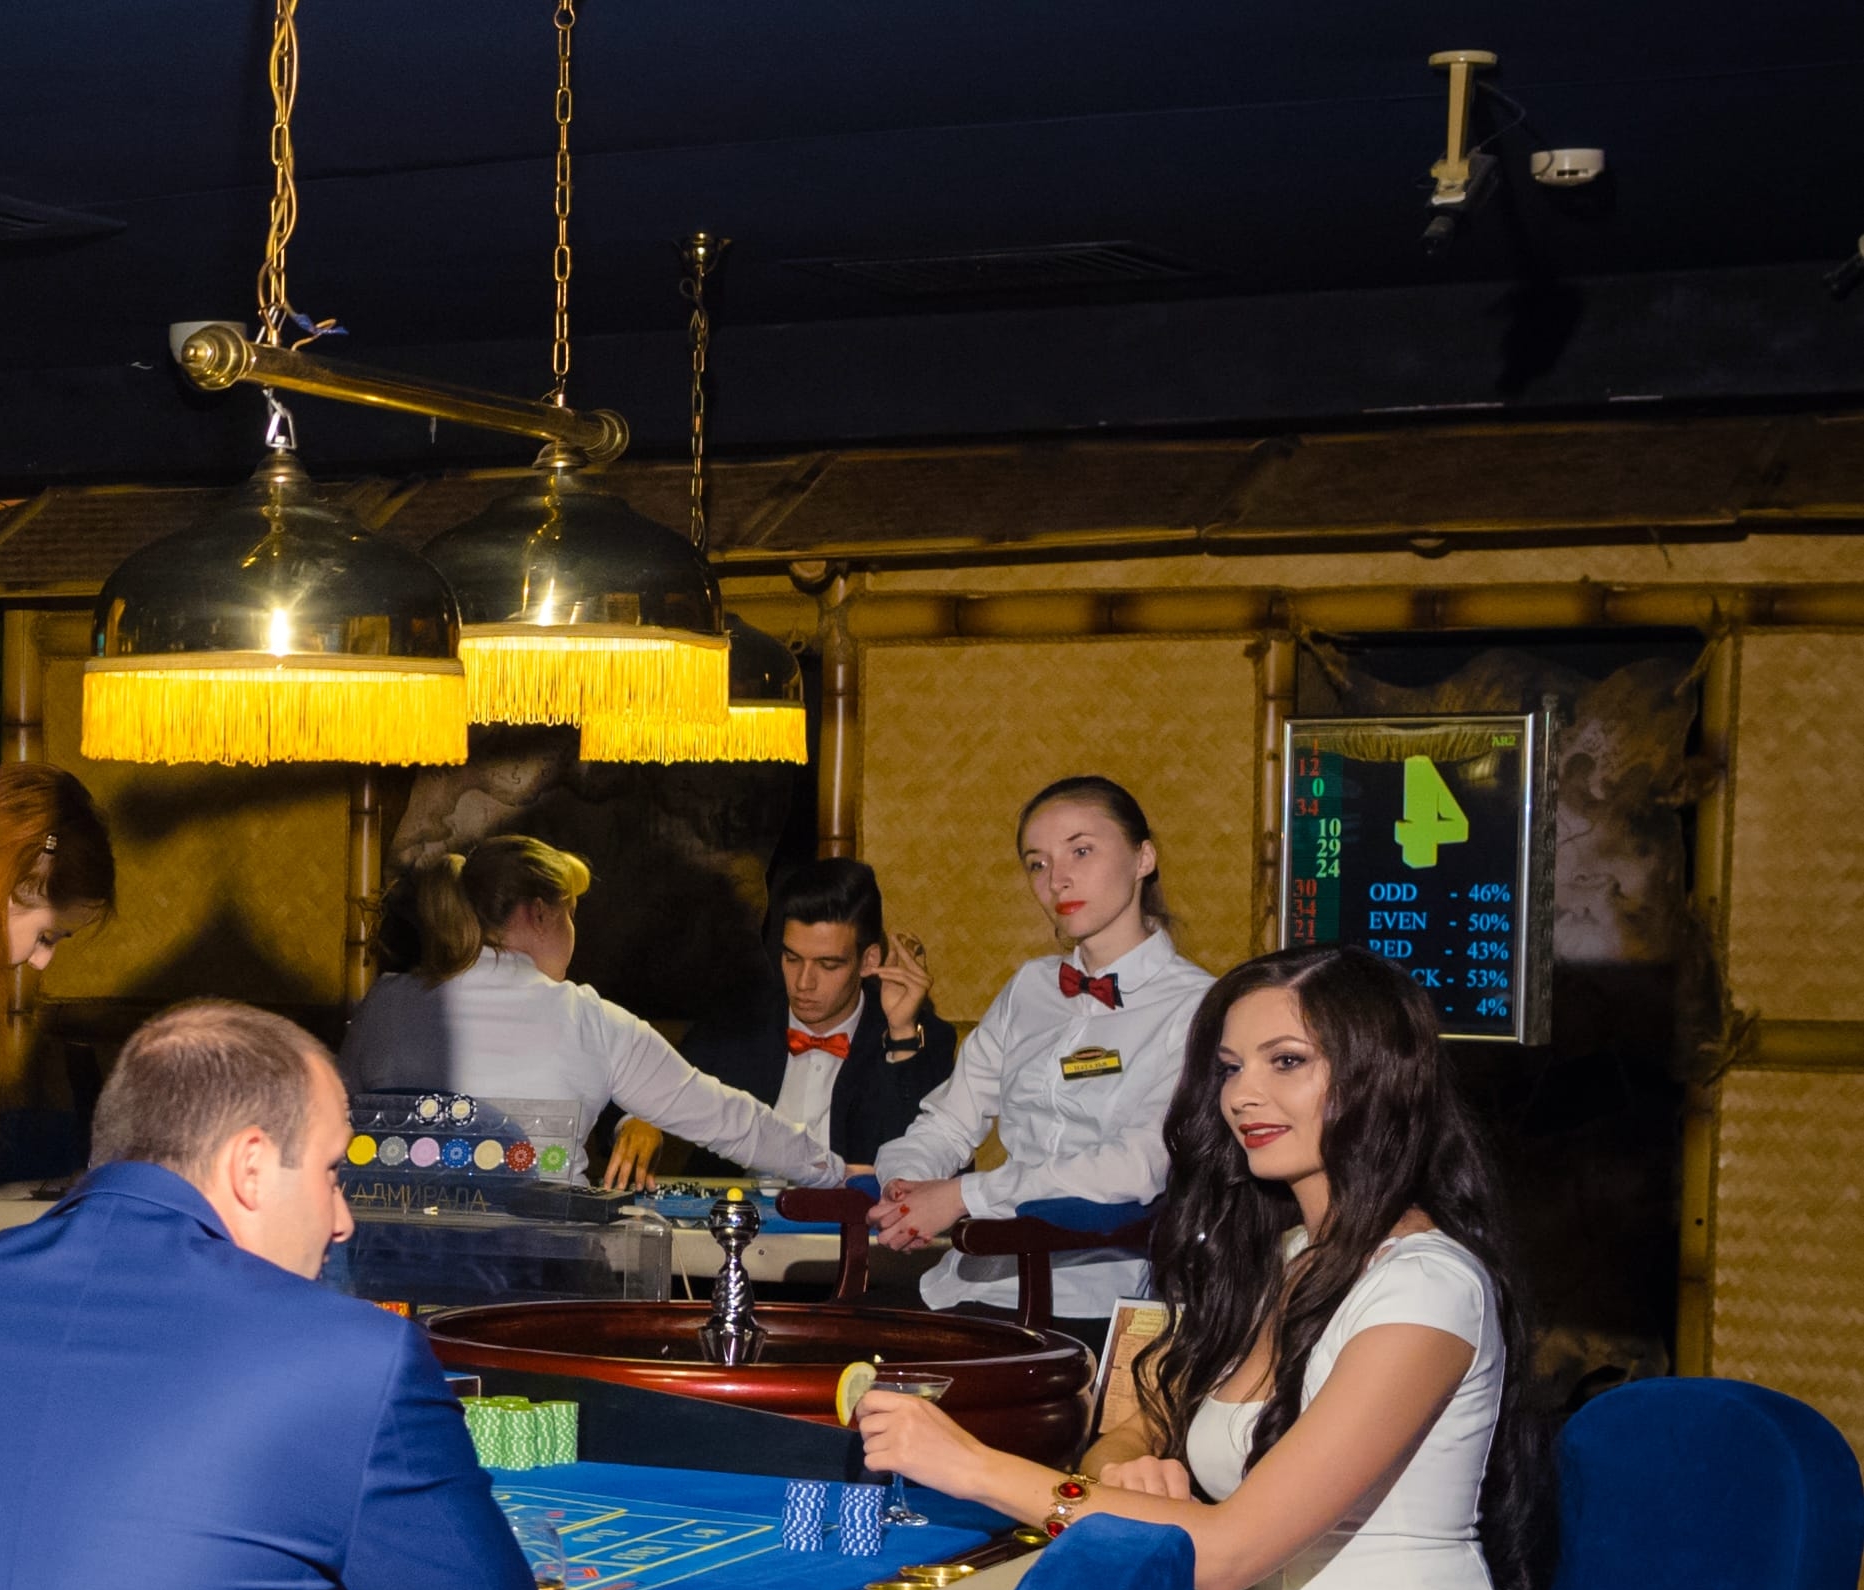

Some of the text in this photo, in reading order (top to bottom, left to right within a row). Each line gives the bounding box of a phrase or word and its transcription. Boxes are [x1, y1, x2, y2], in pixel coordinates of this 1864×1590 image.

[1298, 757, 1320, 776] 12
[1312, 778, 1325, 797] 0
[1394, 755, 1468, 869] 4
[1319, 818, 1342, 837] 10
[1317, 838, 1342, 857] 29
[1316, 859, 1341, 878] 24
[1293, 879, 1317, 897] 30
[1369, 883, 1418, 902] ODD
[1468, 883, 1511, 902] 46%
[1368, 911, 1427, 931] EVEN
[1468, 913, 1510, 932] 50%
[1369, 939, 1413, 958] RED
[1466, 942, 1509, 960] 43%
[1466, 969, 1508, 988] 53%
[1476, 998, 1507, 1017] 4%
[351, 1182, 491, 1213] АДМИРАЛА
